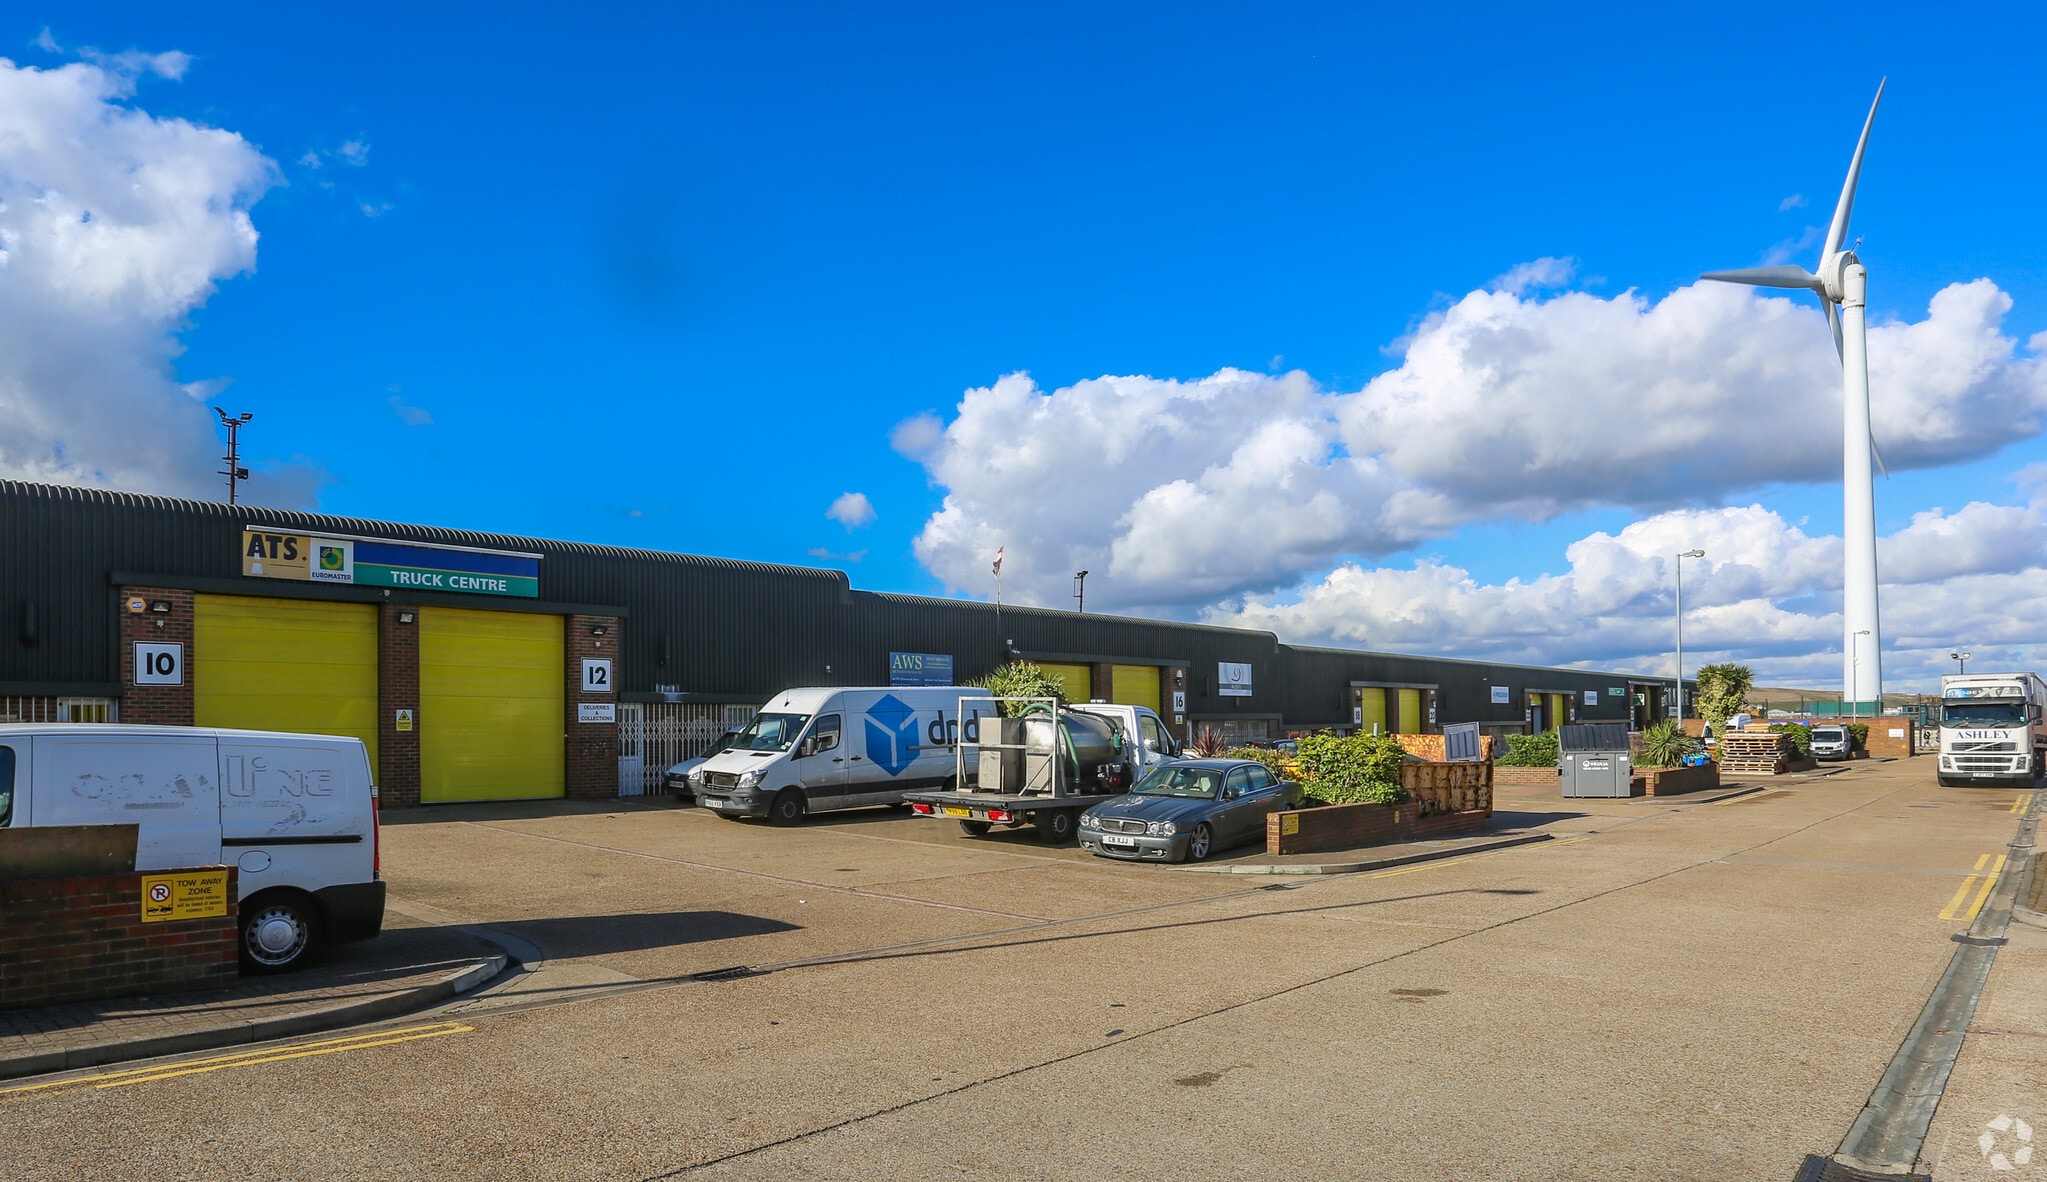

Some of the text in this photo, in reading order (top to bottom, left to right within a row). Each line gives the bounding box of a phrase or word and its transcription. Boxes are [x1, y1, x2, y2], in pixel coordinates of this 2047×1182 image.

[246, 533, 298, 561] ATS
[311, 571, 352, 581] EUROMASTER
[390, 570, 507, 592] TRUCK CENTRE
[146, 652, 175, 676] 10
[892, 654, 923, 670] AWS
[589, 666, 607, 685] 12
[1175, 695, 1184, 708] 16
[1955, 730, 2012, 739] ASHLEY
[177, 877, 223, 887] TOW AWAY
[187, 886, 212, 895] ZONE
